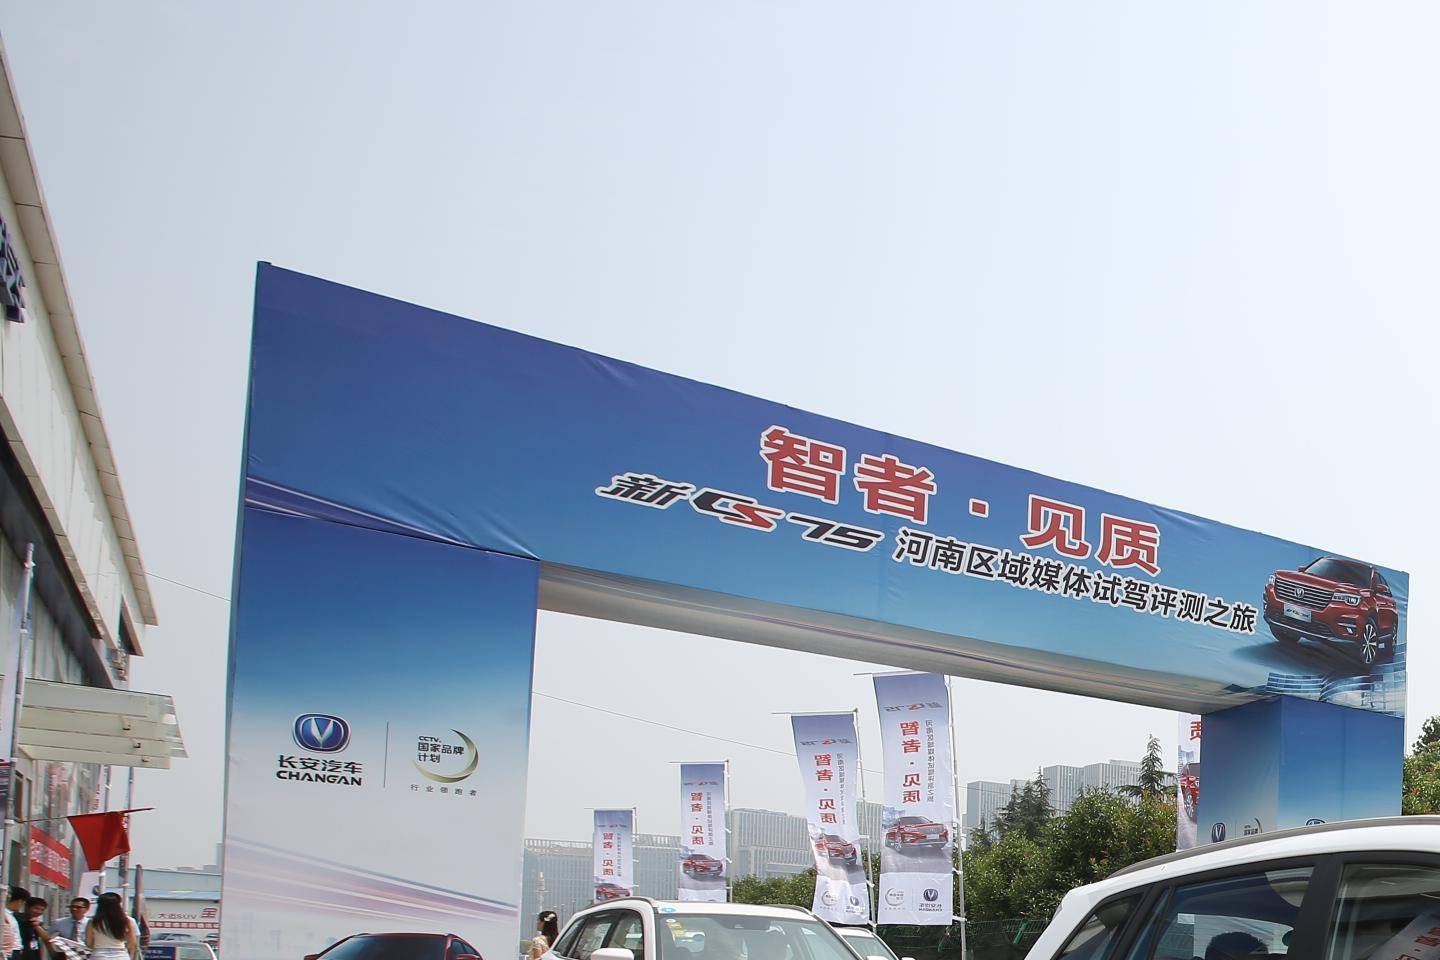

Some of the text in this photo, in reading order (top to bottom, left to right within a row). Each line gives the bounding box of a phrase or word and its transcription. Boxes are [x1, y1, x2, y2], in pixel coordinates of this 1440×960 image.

[761, 427, 1160, 575] 智者·见质
[894, 529, 1257, 633] 河南区域媒体试驾评测之旅
[417, 742, 465, 755] 国家品牌
[278, 755, 363, 774] 长安汽车
[418, 753, 441, 763] 计划
[276, 770, 362, 786] CHANGAN
